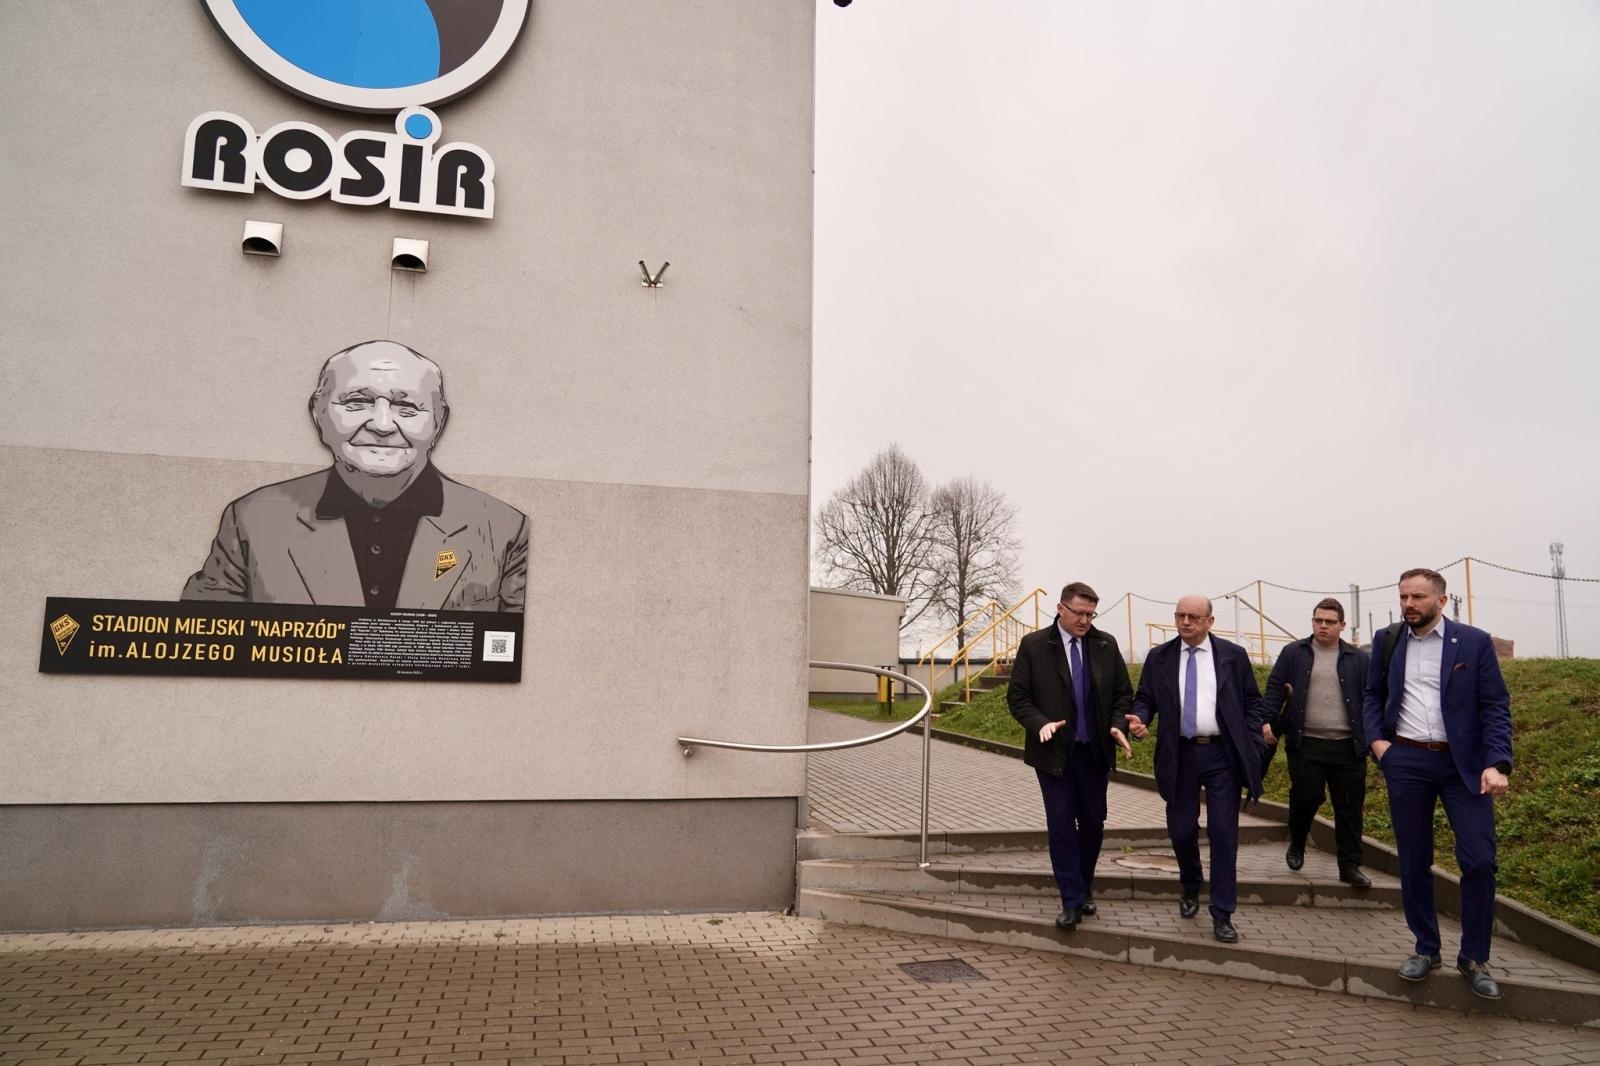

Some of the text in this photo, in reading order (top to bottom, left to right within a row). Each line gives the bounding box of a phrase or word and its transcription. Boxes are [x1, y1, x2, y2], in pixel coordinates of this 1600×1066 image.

[440, 553, 454, 562] GKS
[54, 618, 70, 632] GKS
[92, 614, 169, 634] STADION
[175, 617, 245, 636] MIEJSKI
[250, 618, 346, 639] "NAPRZÓD"
[251, 644, 343, 664] MUSIOŁA
